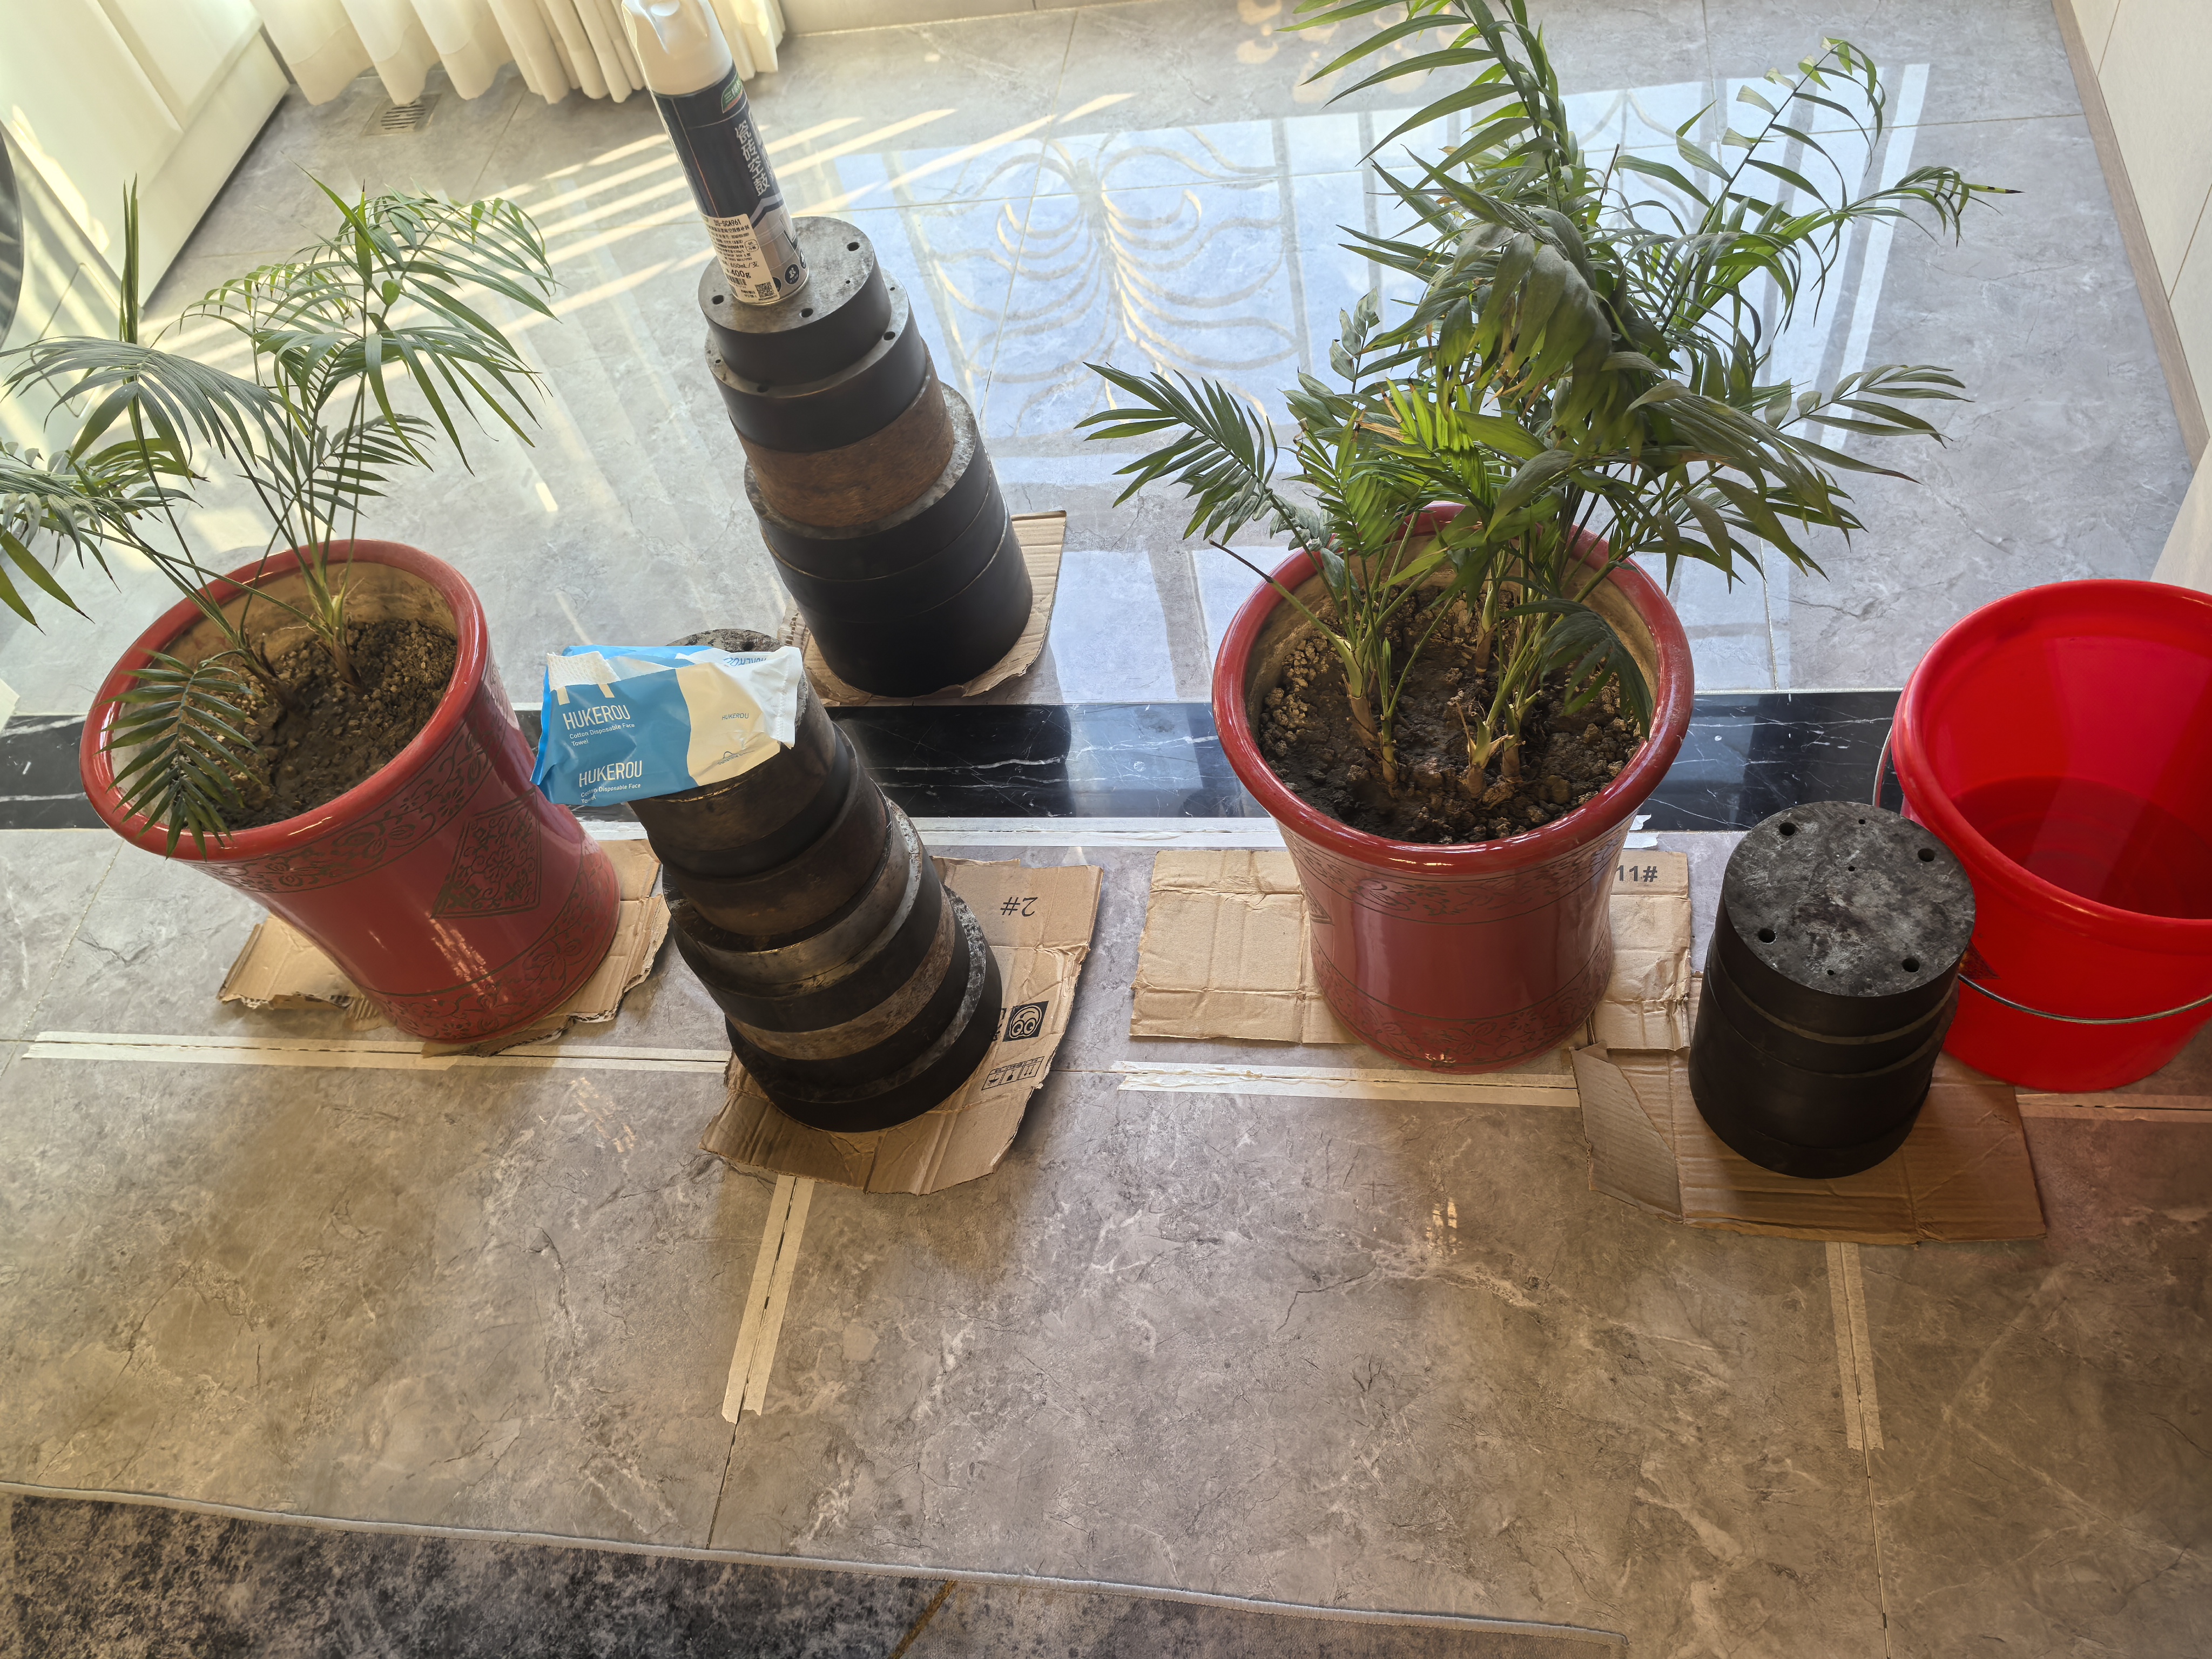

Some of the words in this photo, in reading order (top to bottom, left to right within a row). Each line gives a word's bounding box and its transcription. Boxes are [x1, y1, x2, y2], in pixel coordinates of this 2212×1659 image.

[734, 119, 771, 197] 瓷砖空鼓
[731, 269, 751, 279] 400g
[563, 705, 631, 730] HUKEROU
[721, 712, 749, 720] HUKEROU
[569, 731, 589, 739] Cotton
[589, 724, 622, 735] Disposable
[571, 738, 589, 747] Towel
[579, 760, 642, 787] HUKEROU
[581, 787, 597, 797] Cotton
[598, 785, 628, 793] Disposable
[1616, 865, 1658, 882] 11#
[1000, 896, 1038, 917] 2#
